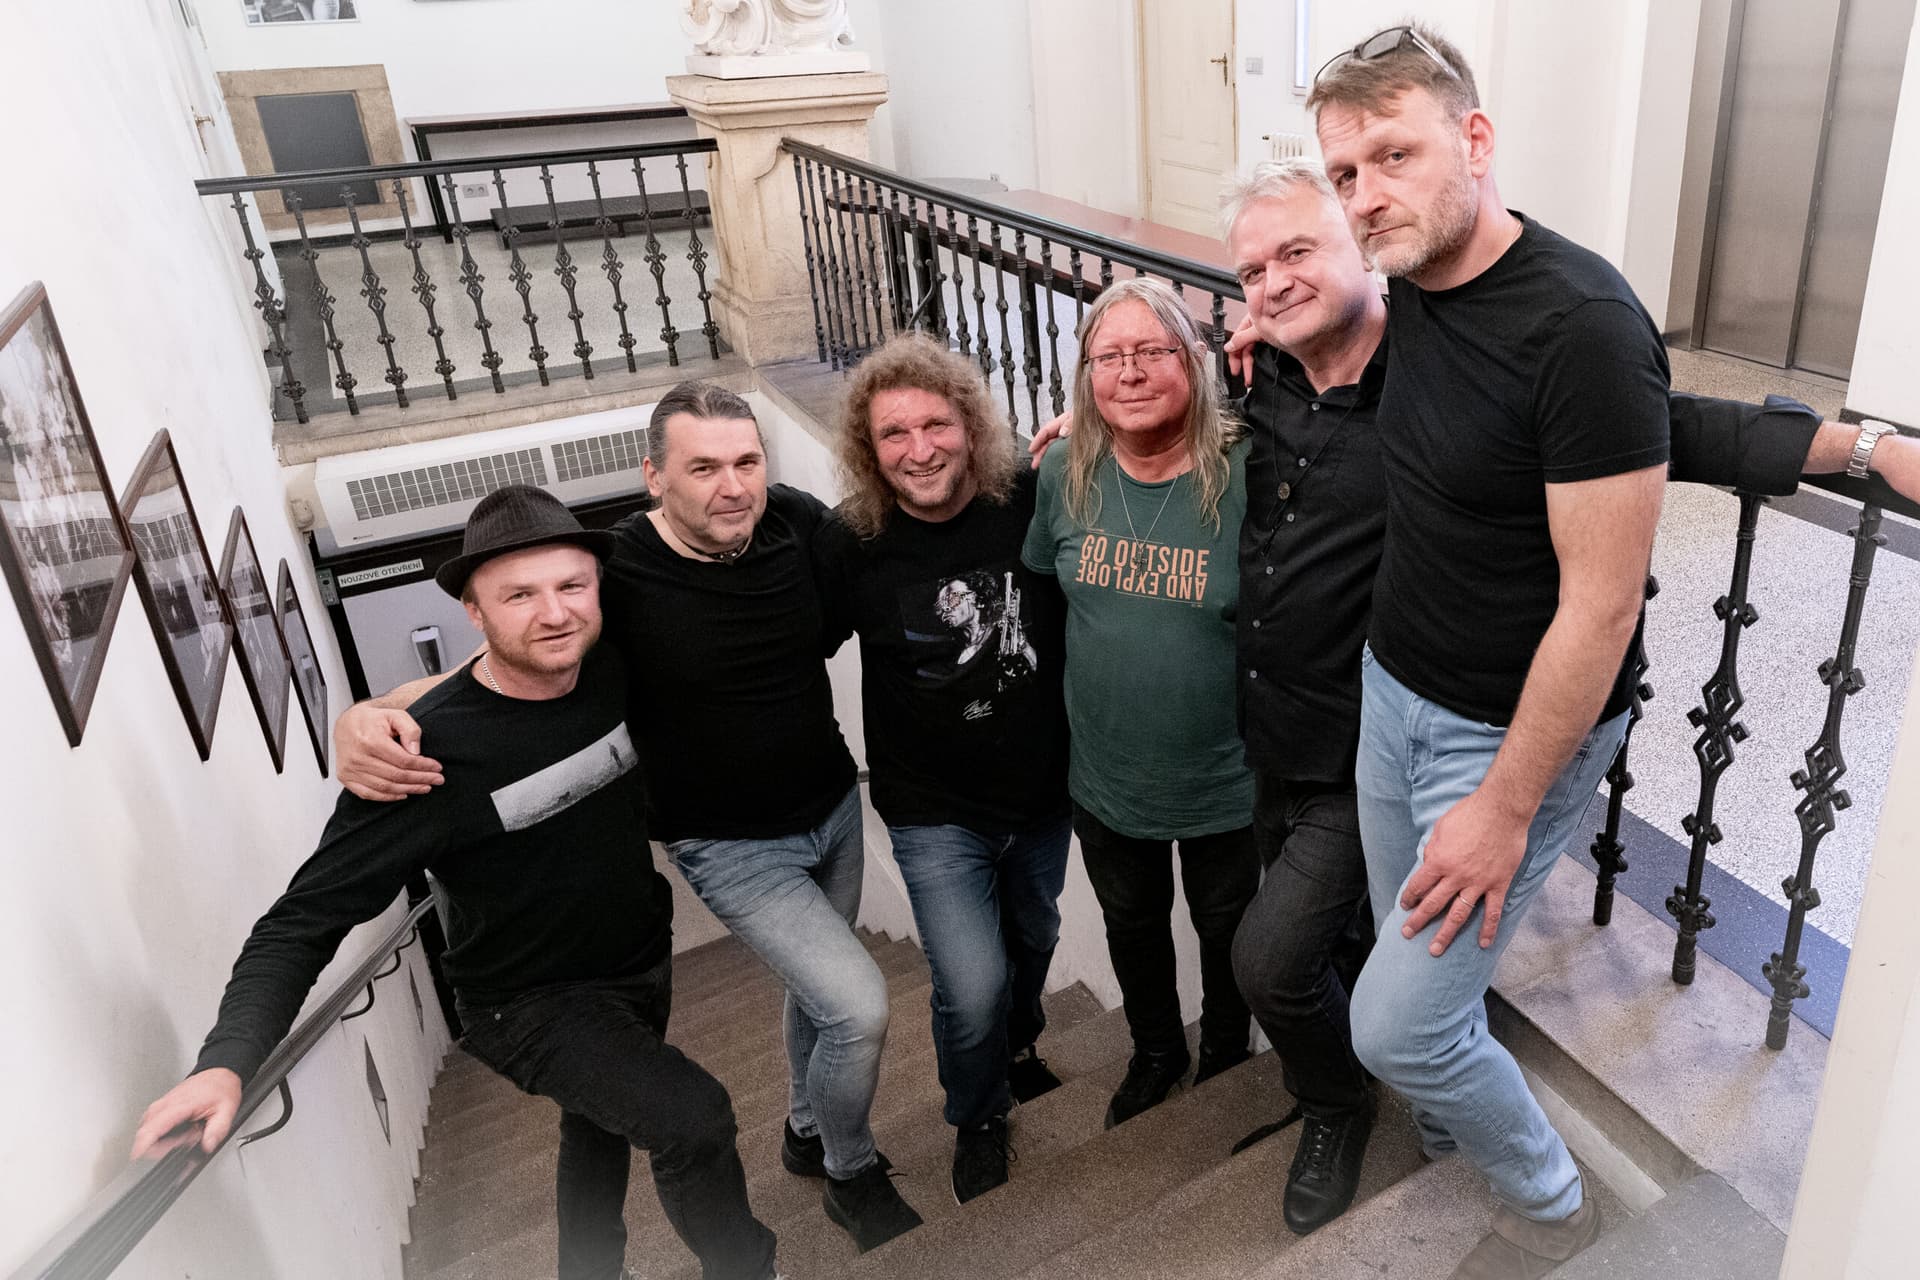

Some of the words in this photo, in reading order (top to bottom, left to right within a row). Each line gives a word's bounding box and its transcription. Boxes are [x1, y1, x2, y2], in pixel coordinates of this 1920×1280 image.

[381, 560, 421, 575] OTEVŘENÍ
[1081, 534, 1108, 563] GO
[1114, 540, 1210, 577] OUTSIDE
[1075, 560, 1159, 596] EXPLORE
[1166, 575, 1207, 601] AND
